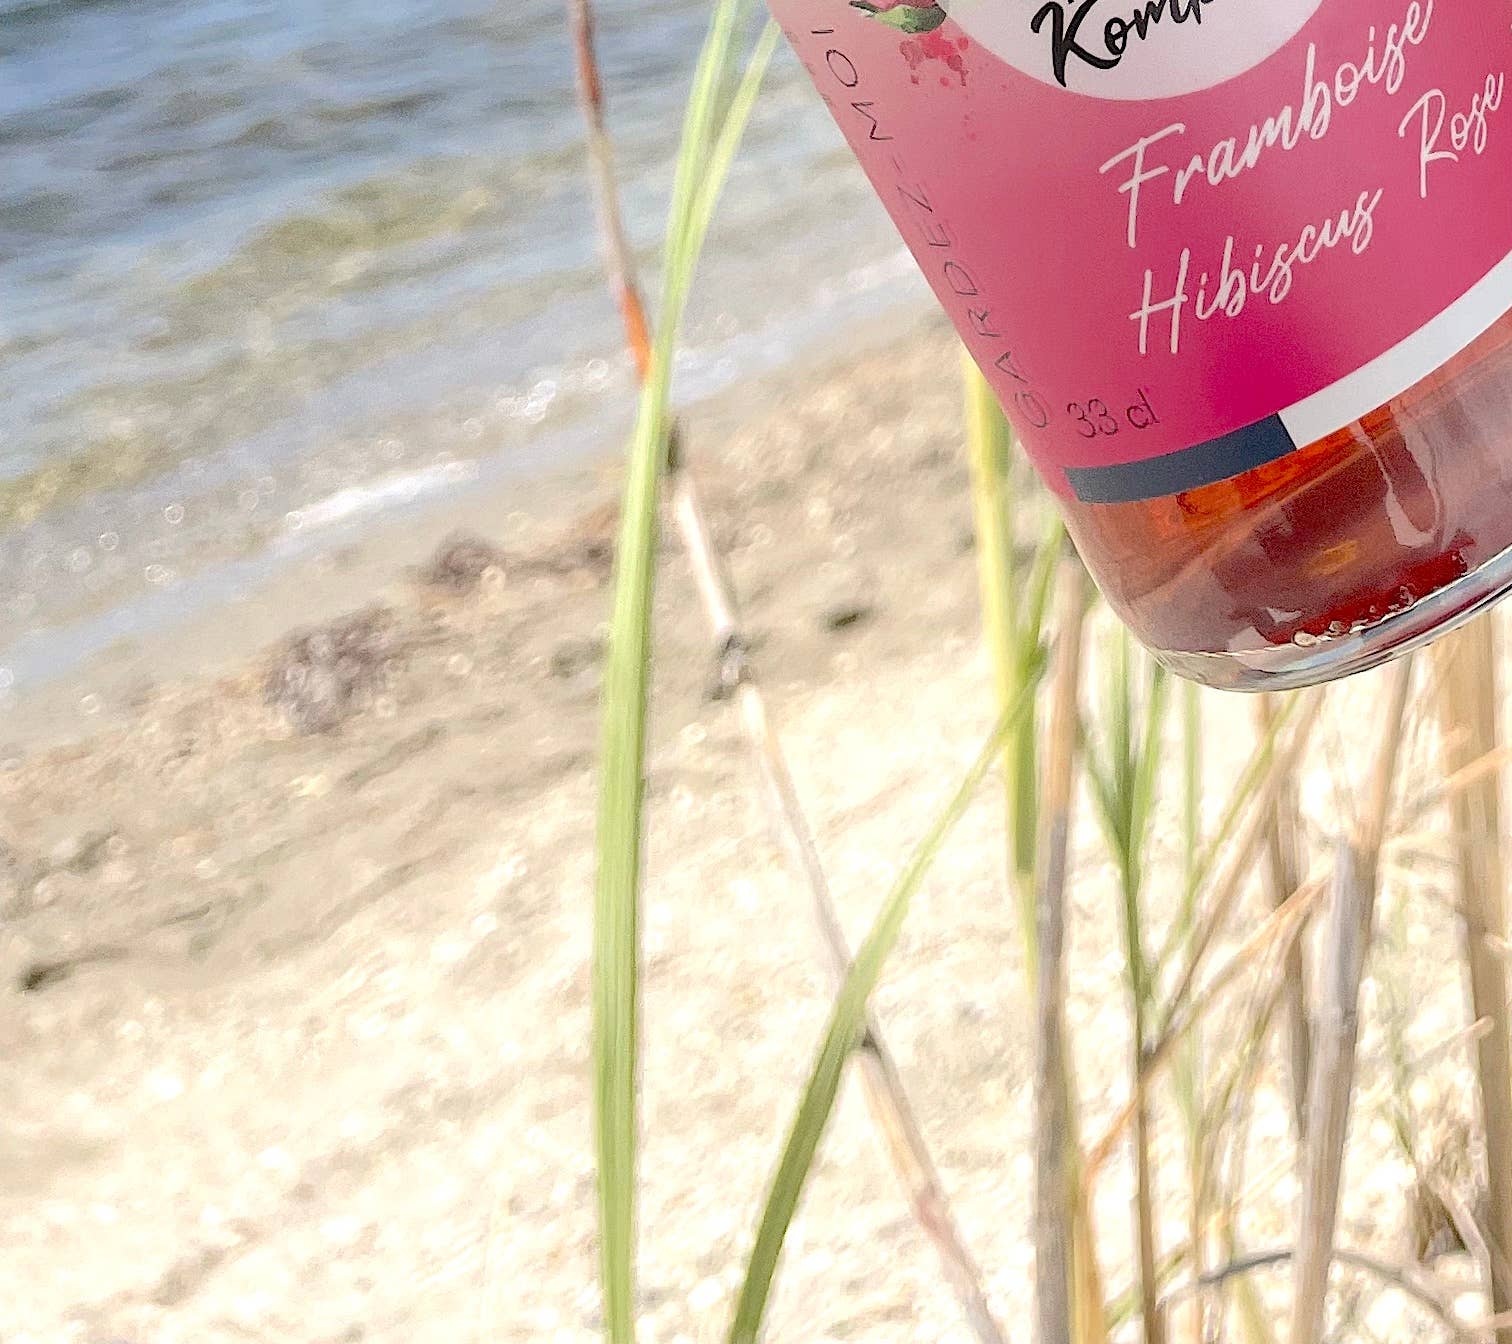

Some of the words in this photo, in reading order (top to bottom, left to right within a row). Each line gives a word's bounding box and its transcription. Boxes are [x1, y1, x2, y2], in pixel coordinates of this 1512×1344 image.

[1129, 188, 1384, 355] Hibiscus
[1398, 72, 1505, 199] Rose
[1066, 397, 1120, 439] 33
[1126, 388, 1161, 429] cl
